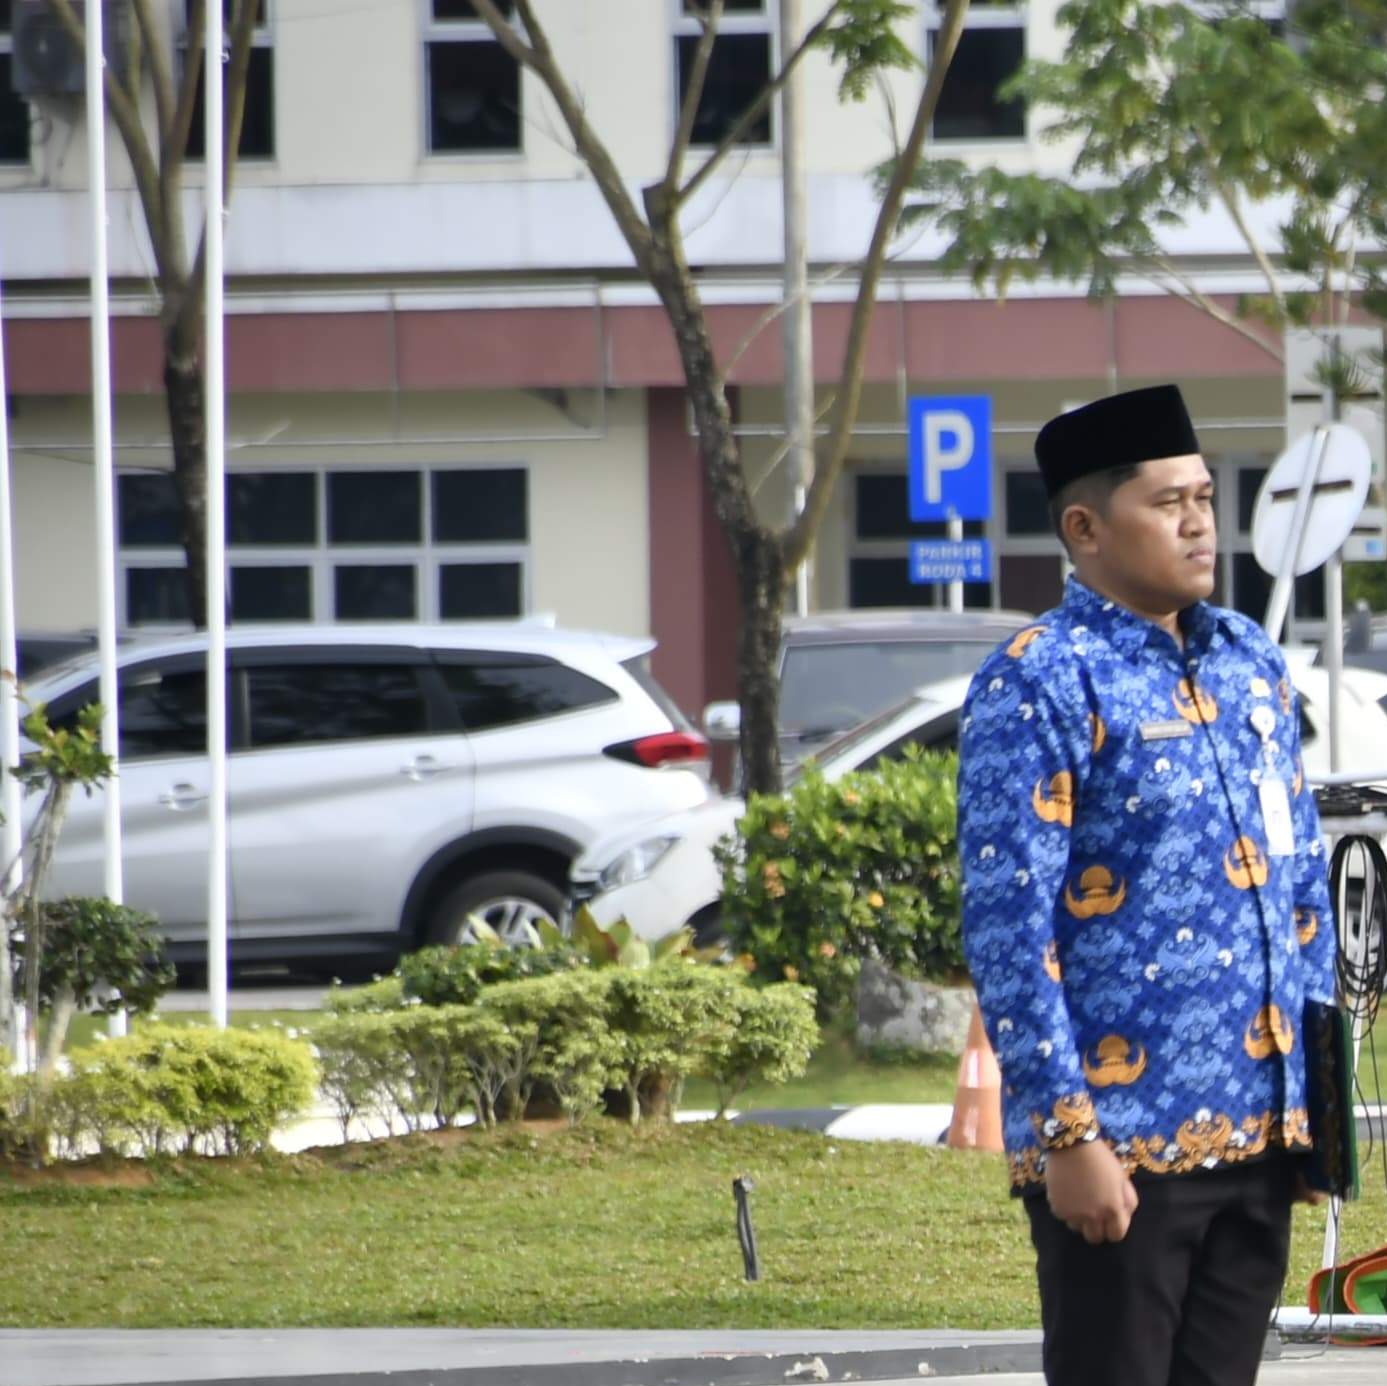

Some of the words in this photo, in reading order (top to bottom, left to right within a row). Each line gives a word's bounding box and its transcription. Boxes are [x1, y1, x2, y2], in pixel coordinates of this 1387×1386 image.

[923, 409, 975, 504] P
[919, 543, 983, 561] PARKIR
[919, 562, 966, 579] RODA
[971, 562, 983, 579] 4
